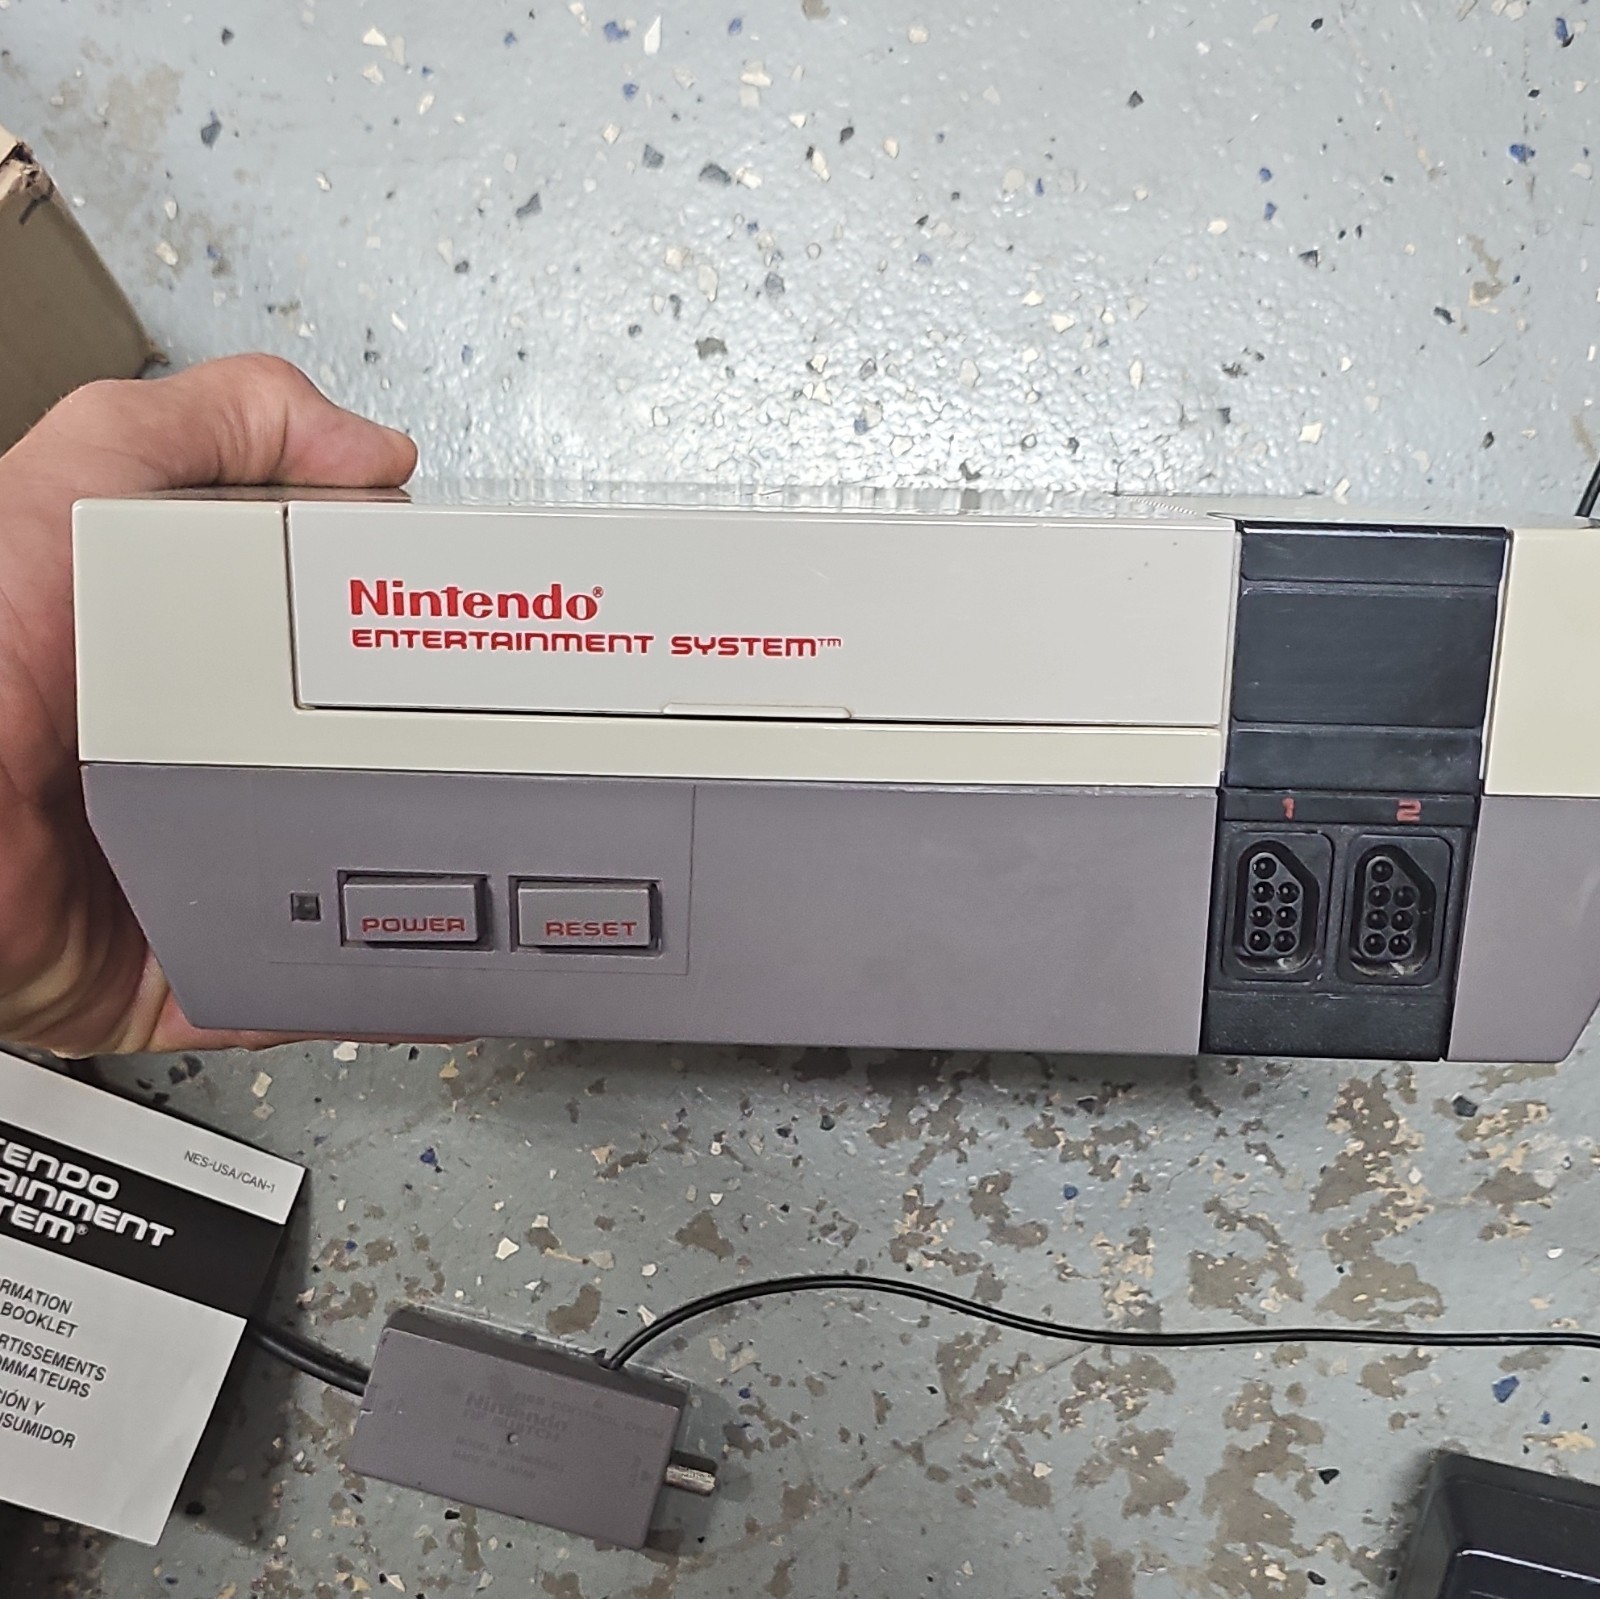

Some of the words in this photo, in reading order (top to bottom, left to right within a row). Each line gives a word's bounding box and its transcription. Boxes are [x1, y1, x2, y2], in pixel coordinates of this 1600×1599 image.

[351, 628, 654, 654] ENTERTAINMENT
[1283, 797, 1295, 820] 1
[1396, 799, 1421, 822] 2
[361, 917, 466, 934] POWER
[544, 921, 637, 938] RESET
[0, 1138, 119, 1200] ENDO
[184, 1150, 275, 1193] NES-USA/CAN-1
[0, 1278, 73, 1315] RMATION
[0, 1301, 78, 1338] BOOKLET
[0, 1333, 107, 1382] RTISSEMENTS
[0, 1354, 91, 1398] MMATEURS
[0, 1389, 31, 1411] IÓN
[34, 1400, 46, 1416] Y
